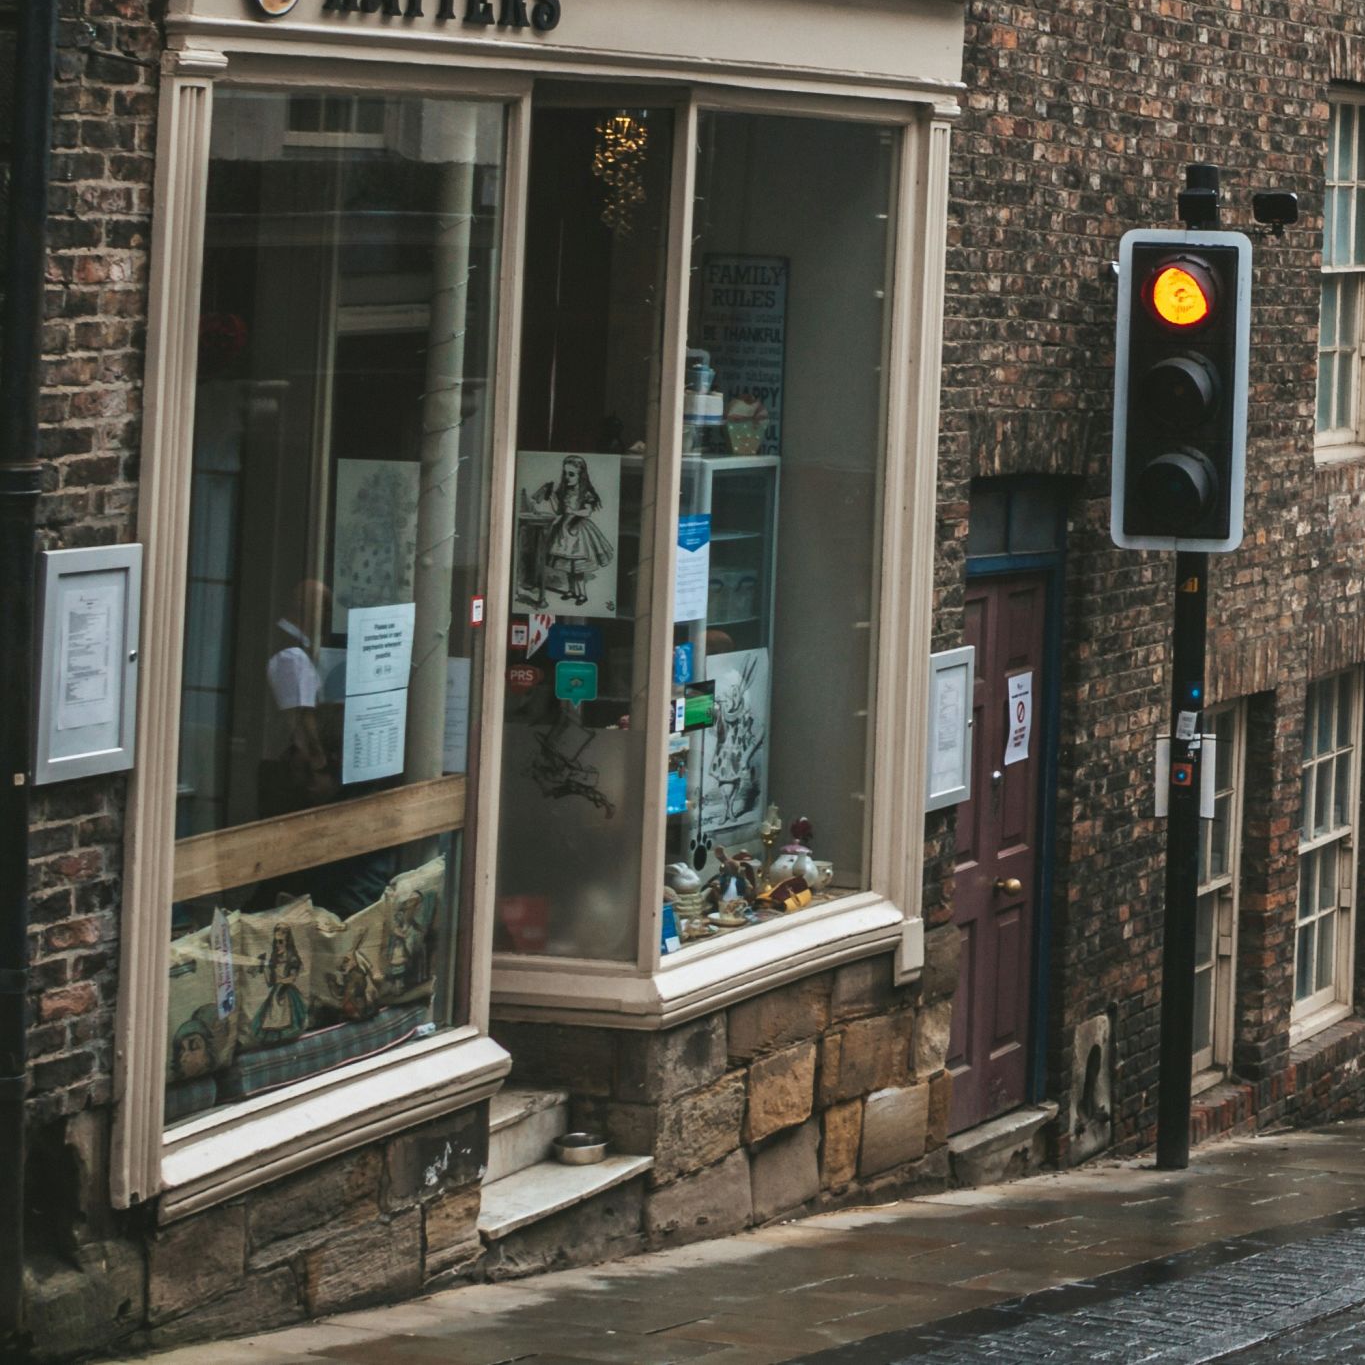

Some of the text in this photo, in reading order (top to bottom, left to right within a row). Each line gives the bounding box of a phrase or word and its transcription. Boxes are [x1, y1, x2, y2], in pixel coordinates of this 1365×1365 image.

[708, 264, 785, 285] FAMILY
[711, 288, 776, 308] RULES
[723, 325, 783, 343] THANKFUL
[510, 669, 534, 681] PRS
